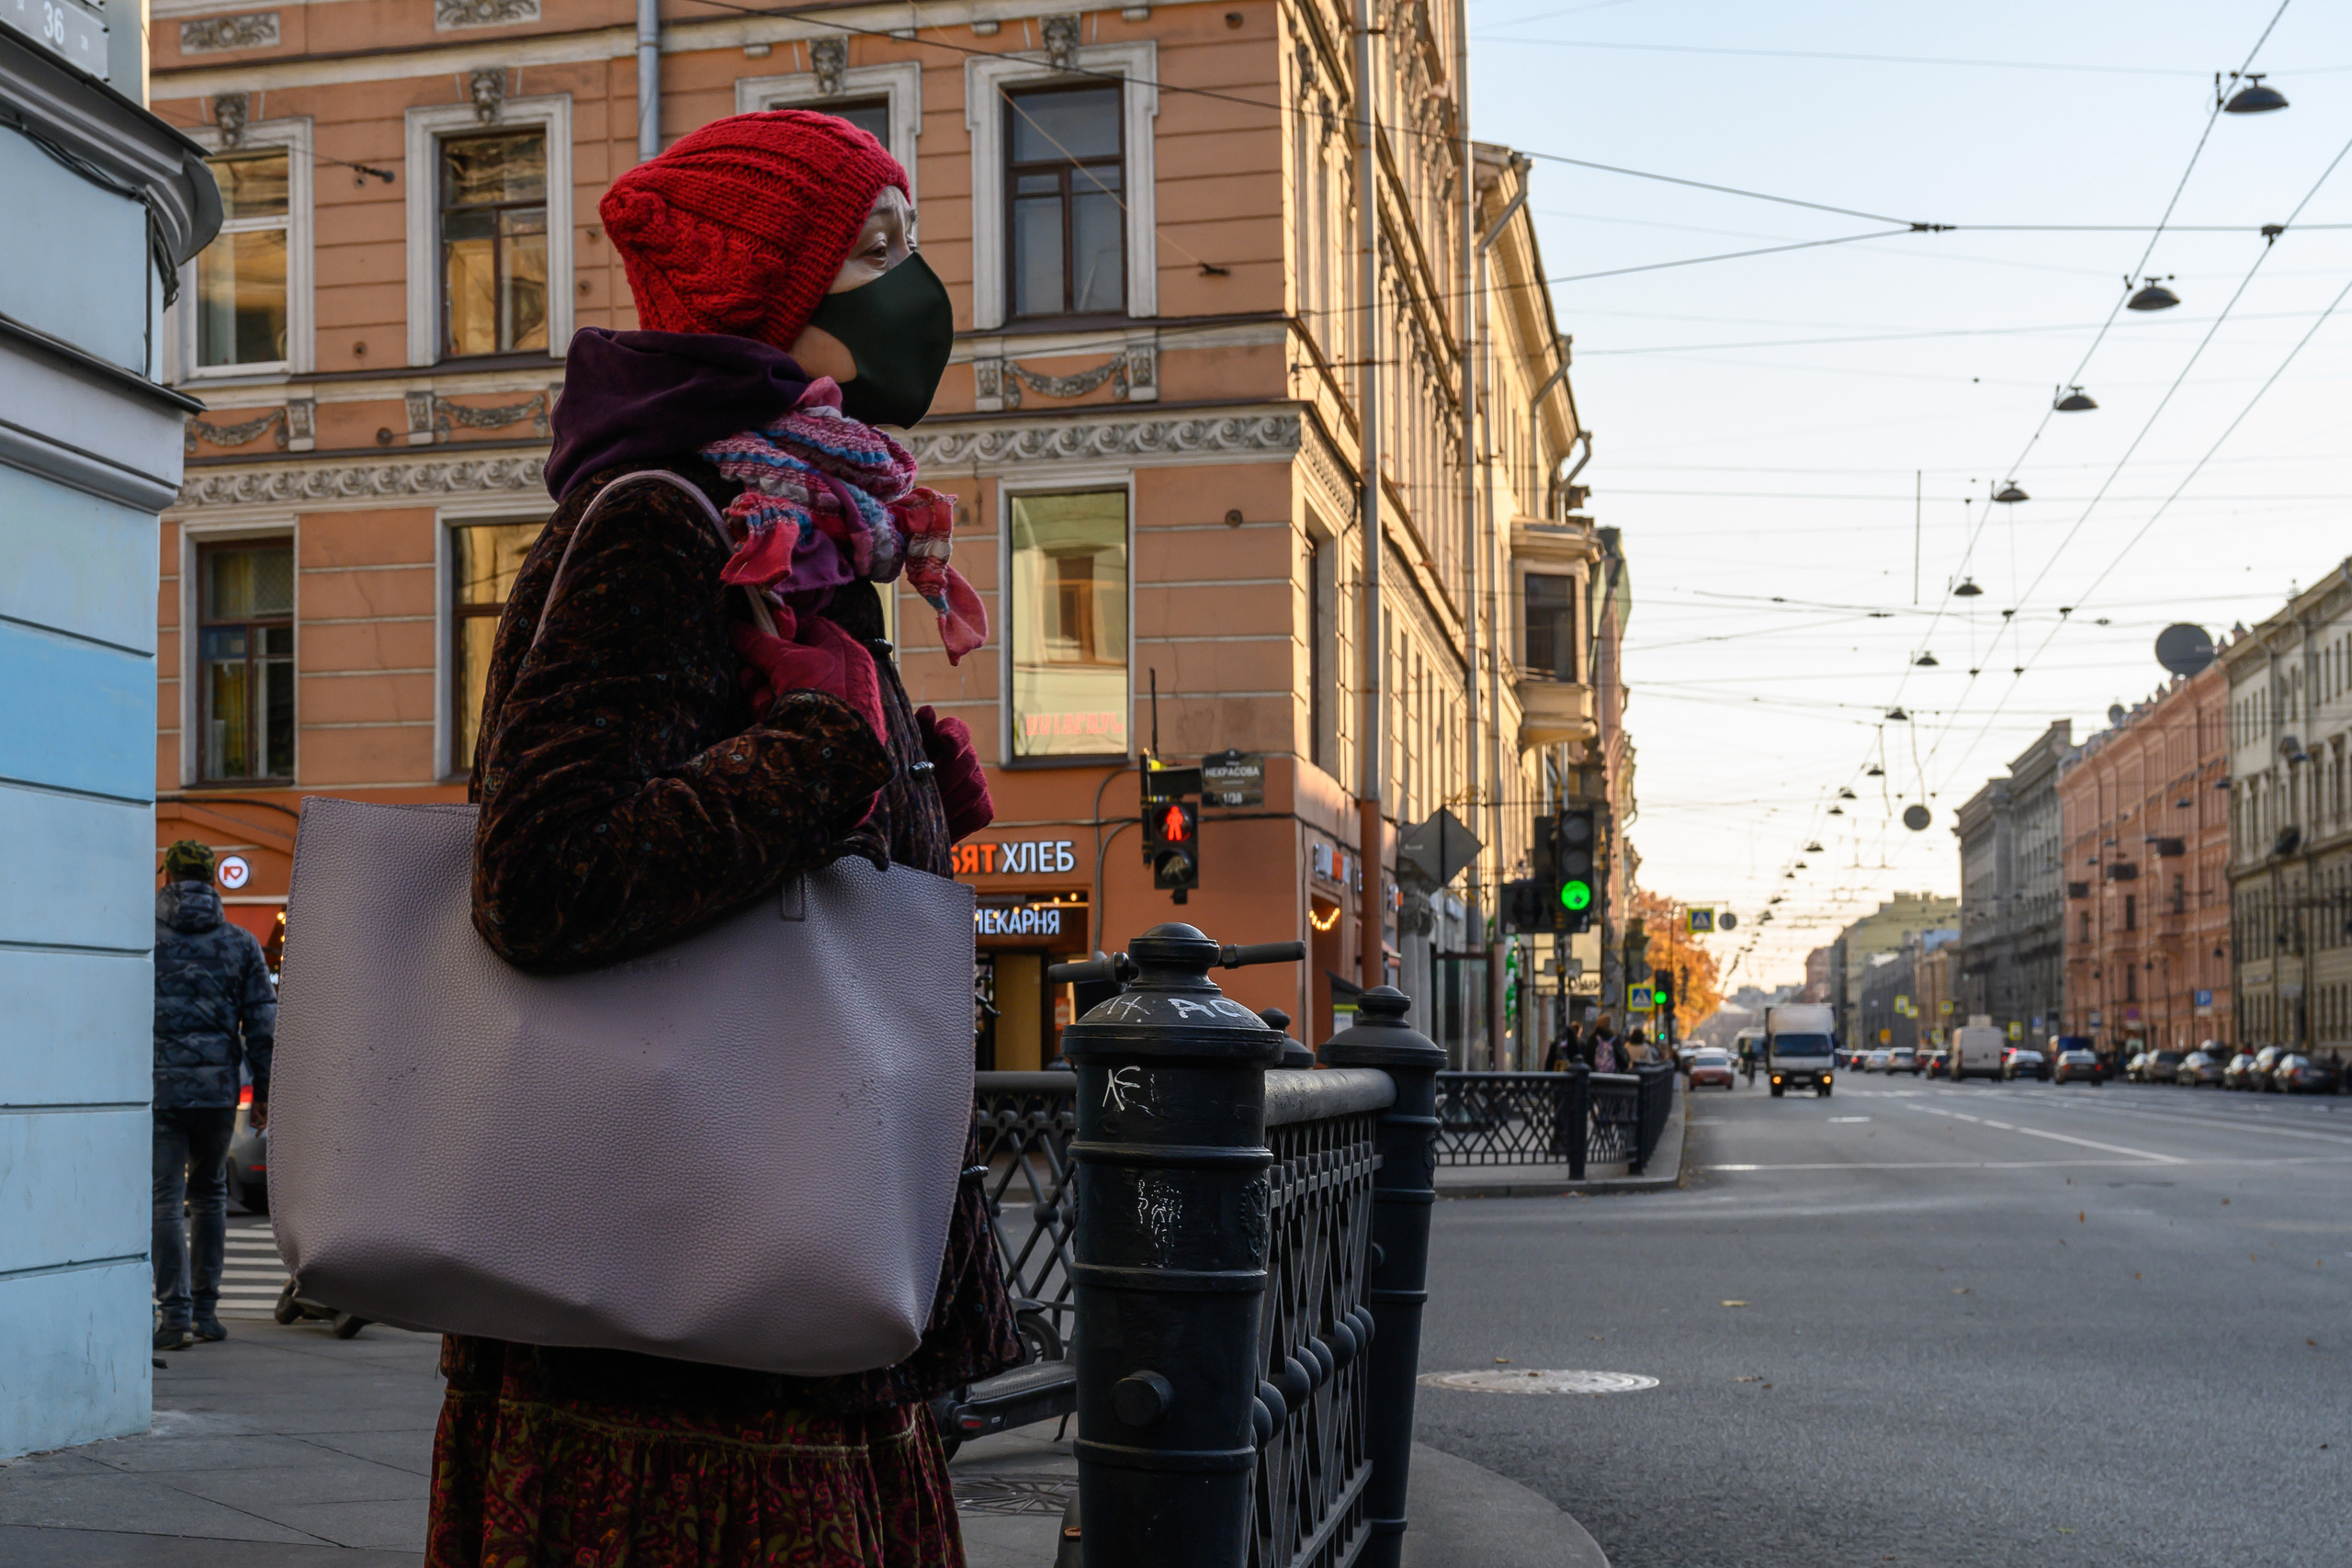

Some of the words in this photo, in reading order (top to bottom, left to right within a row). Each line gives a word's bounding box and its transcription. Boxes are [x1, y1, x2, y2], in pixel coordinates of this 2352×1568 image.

[43, 1, 64, 45] 36
[1205, 764, 1260, 778] НЕКРАСОВА
[1002, 841, 1075, 873] ХЛЕБ
